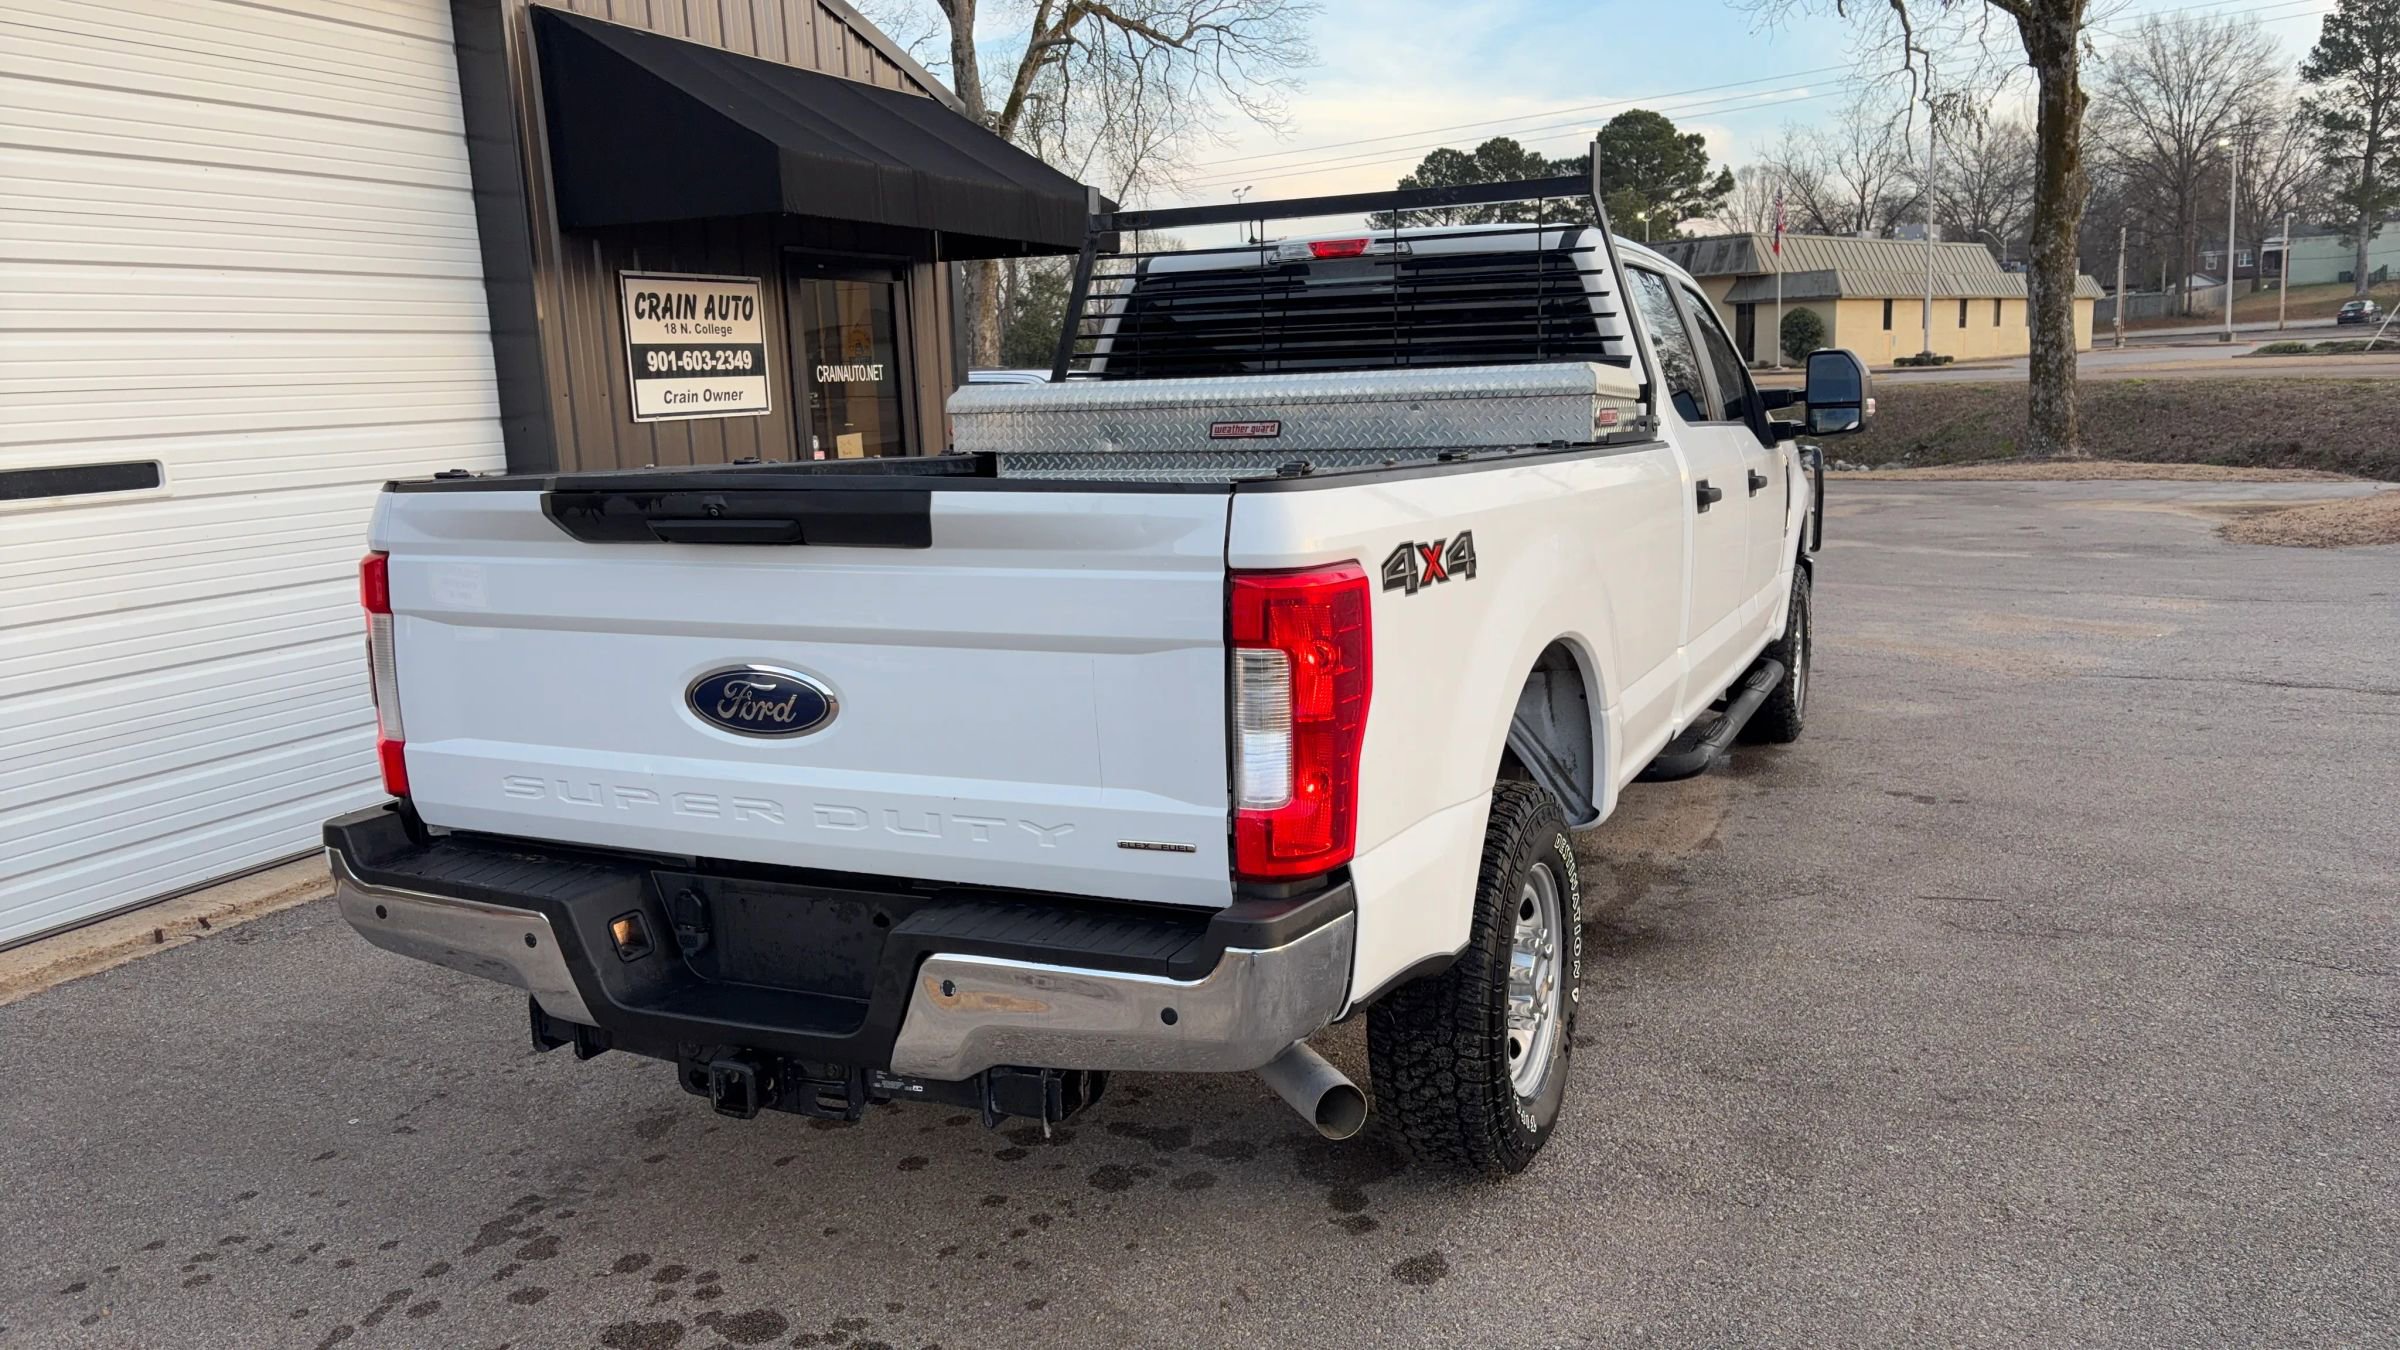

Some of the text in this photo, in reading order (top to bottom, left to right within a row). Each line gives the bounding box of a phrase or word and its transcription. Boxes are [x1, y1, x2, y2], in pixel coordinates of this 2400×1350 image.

[634, 292, 754, 322] CRAIN AUTO
[664, 323, 733, 337] 18 N. College
[647, 350, 753, 371] 901-603-2349
[816, 364, 884, 382] CRAINAUTO.NET
[664, 388, 744, 404] Crain Owner
[1214, 423, 1276, 434] weather guard
[716, 679, 800, 724] Ford
[503, 774, 1077, 849] SUPER DUTY
[1553, 833, 1581, 978] DESTINATION
